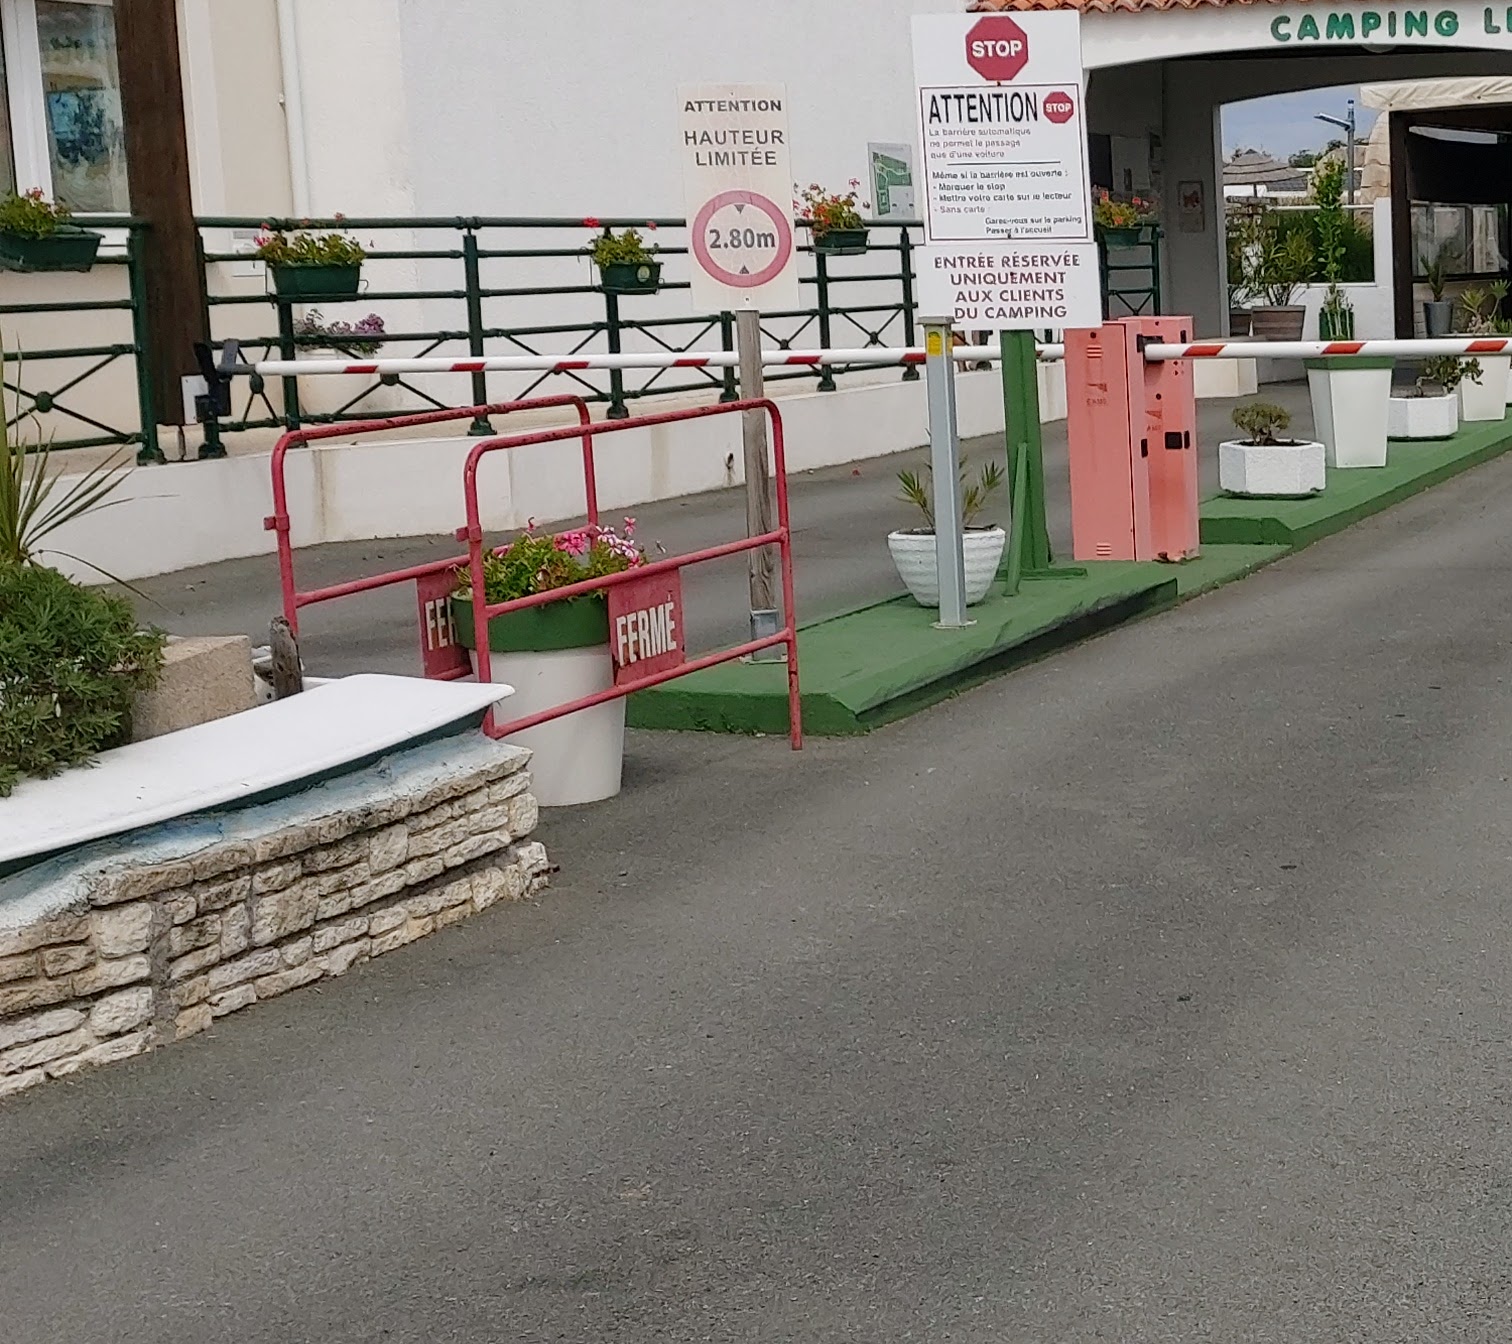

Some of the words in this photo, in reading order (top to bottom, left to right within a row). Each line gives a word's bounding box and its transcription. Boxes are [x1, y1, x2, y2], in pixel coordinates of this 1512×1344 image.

[1270, 9, 1460, 42] CAMPING
[971, 40, 1023, 59] STOP
[684, 99, 782, 112] ATTENTION
[928, 91, 1038, 124] ATTENTION
[1045, 102, 1072, 113] STOP
[684, 129, 785, 146] HAUTEUR
[978, 128, 1031, 137] automatique
[695, 147, 777, 166] LIMITÉE
[709, 228, 776, 249] 2.80m
[934, 252, 994, 269] ENTRÉE
[1001, 250, 1080, 268] RÉSERVÉE
[950, 271, 1067, 286] UNIQUEMENT
[955, 289, 994, 303] AUX
[1000, 288, 1064, 302] CLIENTS
[954, 307, 978, 319] DU
[984, 305, 1067, 319] CAMPING
[615, 590, 677, 667] FERMÉ
